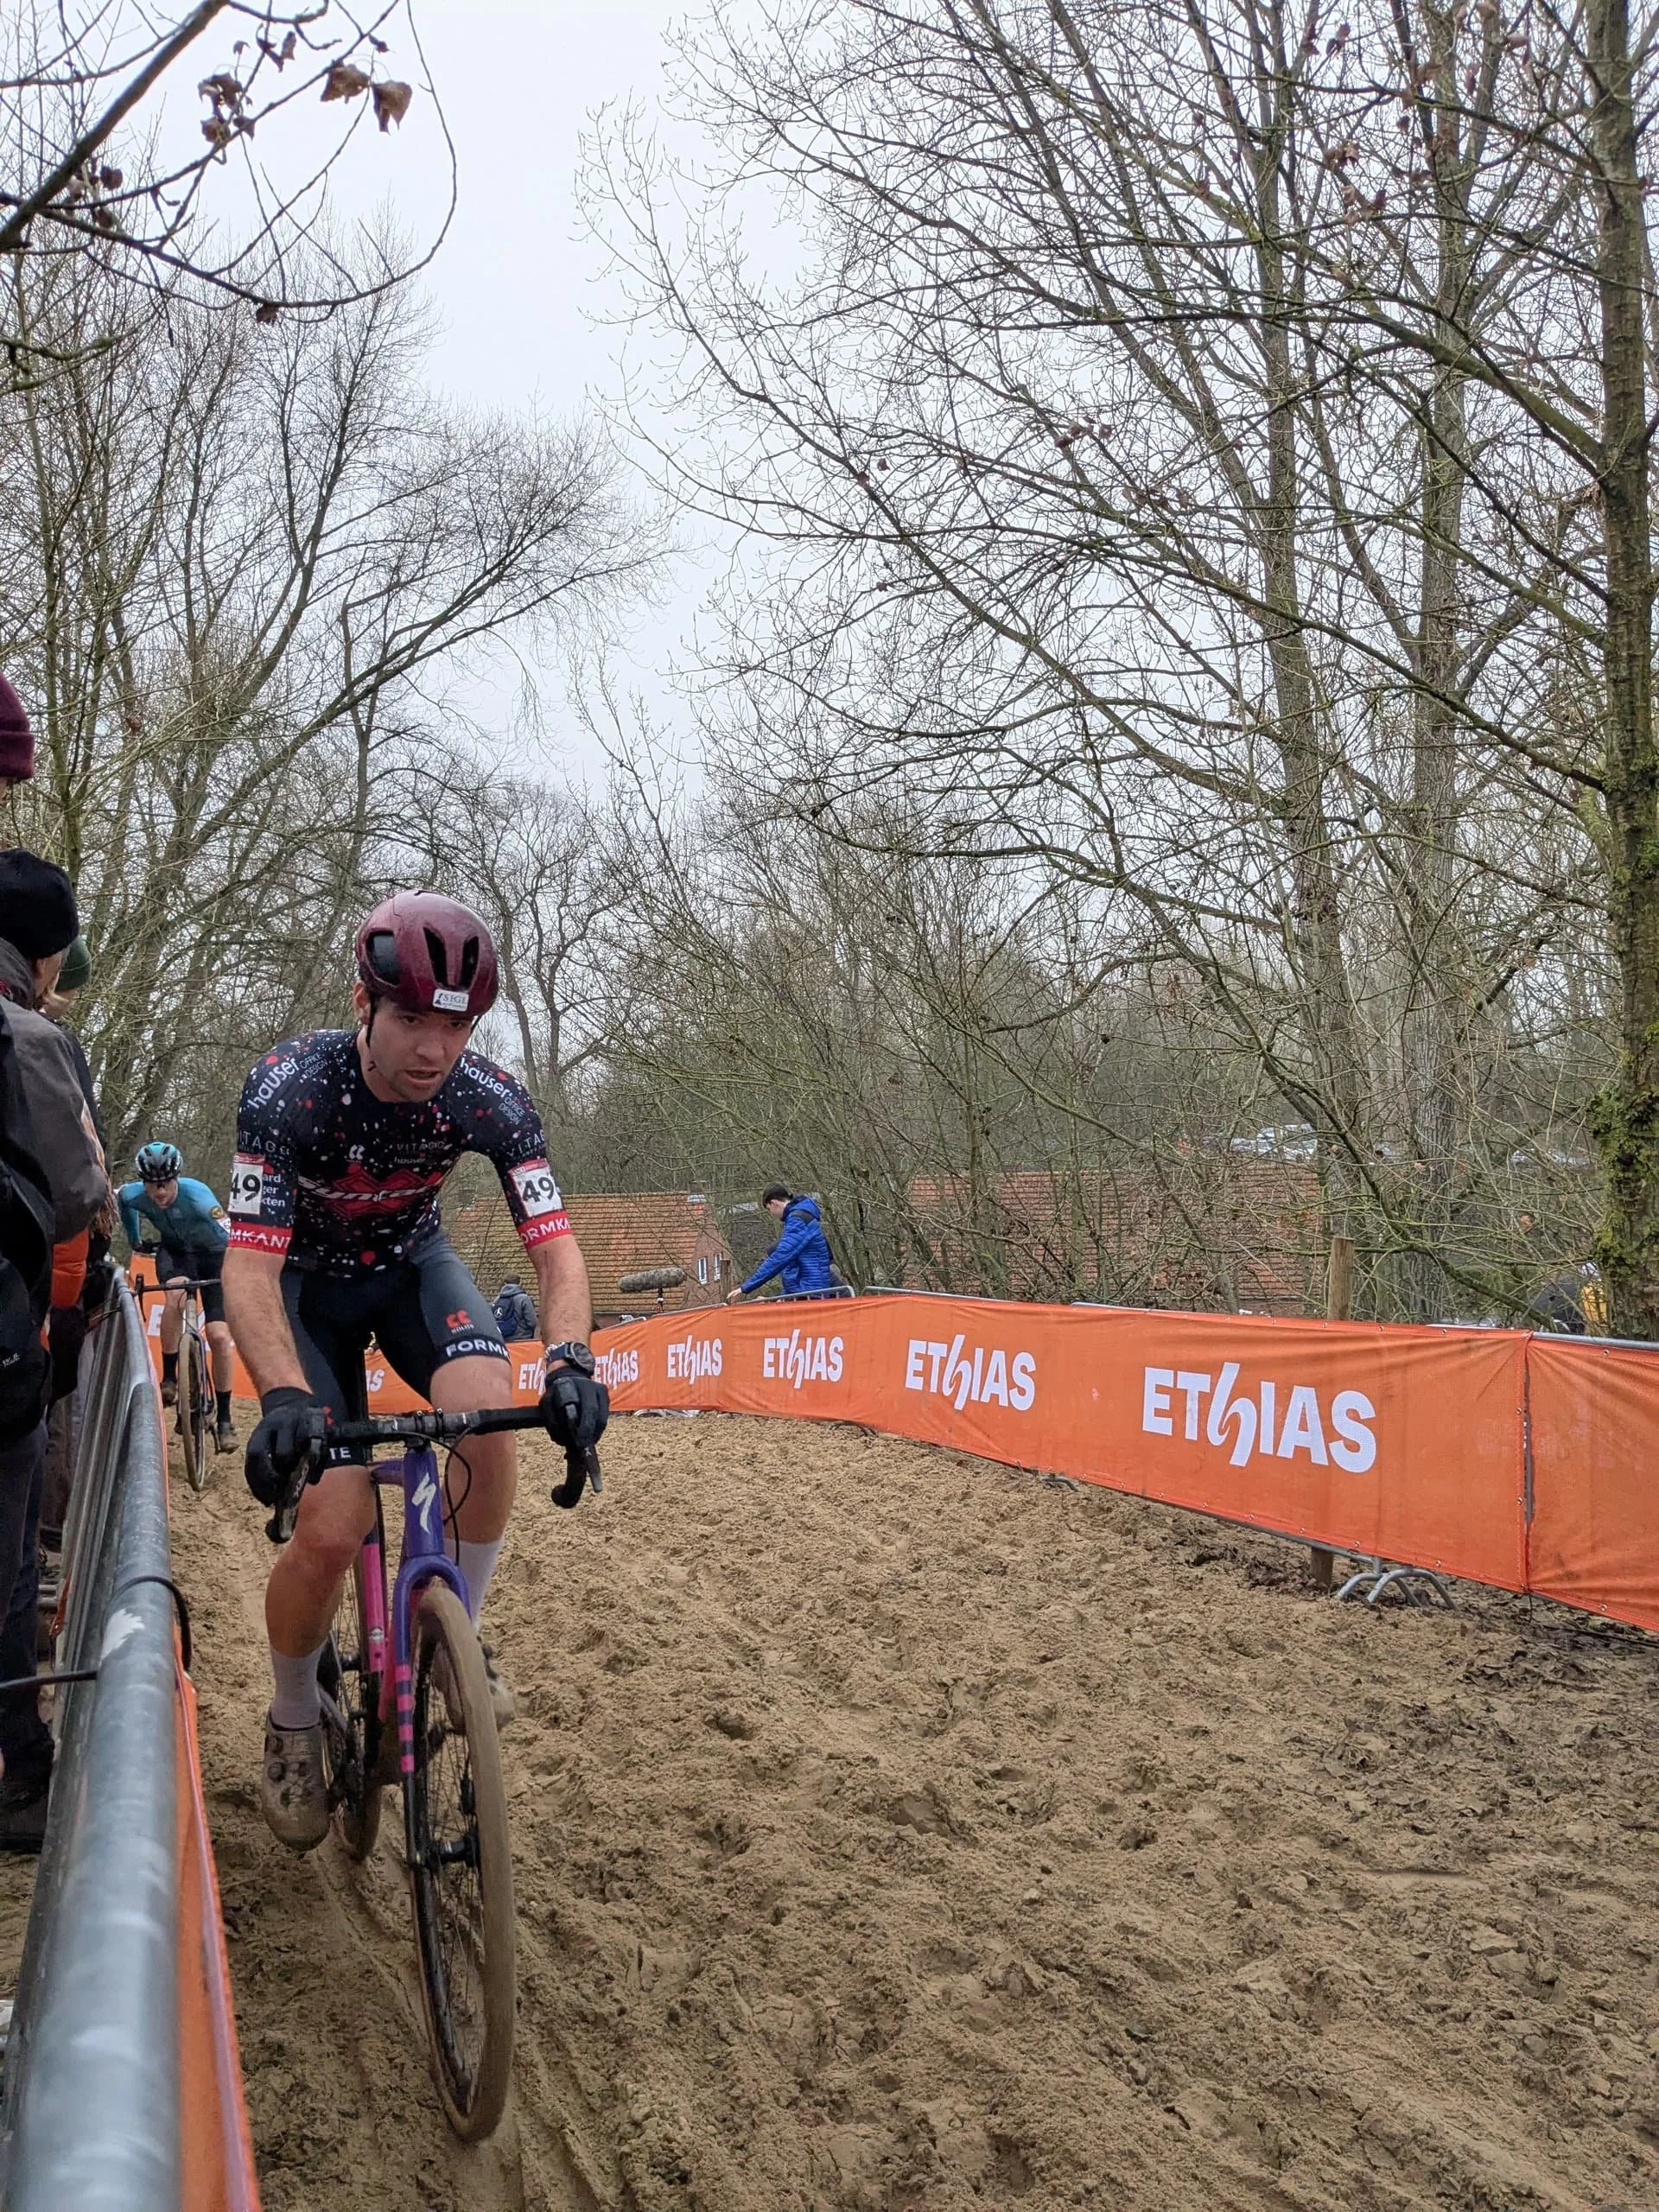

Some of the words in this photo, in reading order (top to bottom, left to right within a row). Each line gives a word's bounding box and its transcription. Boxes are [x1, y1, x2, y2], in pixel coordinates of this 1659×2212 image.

[247, 1058, 300, 1109] hauser
[460, 1057, 512, 1097] hauser
[231, 1173, 260, 1202] 49
[523, 1177, 554, 1203] 49
